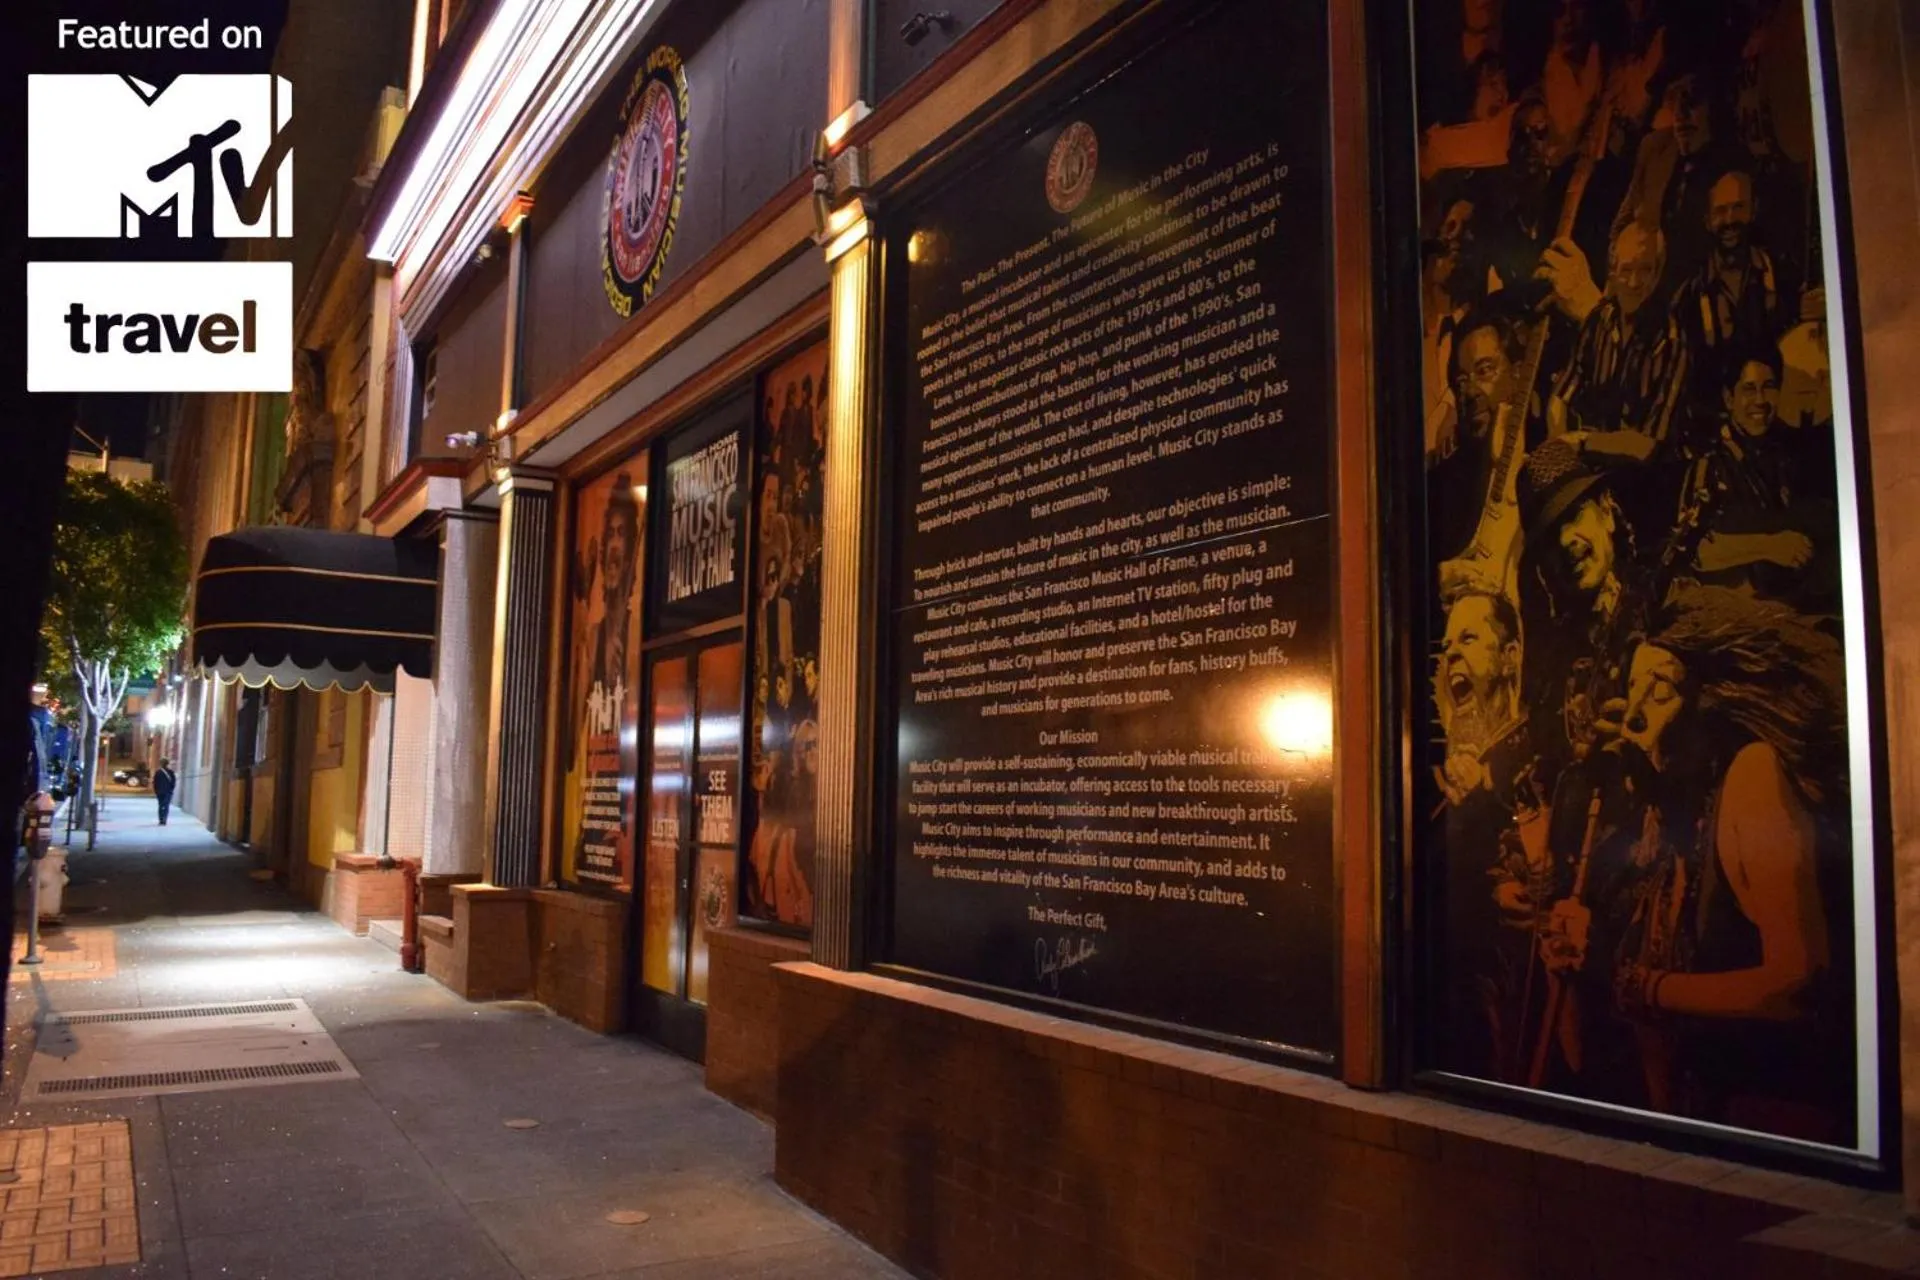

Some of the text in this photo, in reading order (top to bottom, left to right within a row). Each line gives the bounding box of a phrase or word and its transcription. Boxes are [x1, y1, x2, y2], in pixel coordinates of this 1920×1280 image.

[1211, 163, 1289, 211] be drawn to
[643, 127, 693, 303] MUSICIAN
[1146, 190, 1282, 267] movement of the beat
[1137, 217, 1276, 298] gave us the Summer of
[1127, 298, 1162, 323] 1970's
[1163, 285, 1186, 307] and
[1218, 269, 1231, 283] to
[1234, 257, 1256, 276] the
[1155, 318, 1167, 335] of
[1169, 312, 1189, 329] the
[1237, 282, 1262, 300] San
[1132, 302, 1276, 368] working musician and a
[1185, 356, 1206, 372] has
[1208, 333, 1255, 363] eroded
[1257, 326, 1281, 345] the
[1240, 352, 1277, 382] quick
[1140, 380, 1289, 441] physical community has
[1158, 409, 1284, 456] Music City stands as
[689, 441, 739, 503] FRANCISCO
[671, 484, 737, 552] MUSIC
[1085, 520, 1106, 537] and
[1145, 508, 1167, 522] our
[1168, 492, 1226, 516] objective
[1228, 486, 1239, 501] is
[1241, 474, 1291, 498] simple:
[1089, 547, 1099, 559] in
[1101, 542, 1119, 557] the
[1144, 535, 1158, 547] as
[1159, 525, 1185, 543] well
[1186, 525, 1200, 537] as
[1203, 517, 1224, 533] the
[667, 530, 735, 604] HALL OF FAME
[1076, 601, 1091, 612] an
[1091, 591, 1135, 609] Internet
[1138, 585, 1153, 601] TV
[1203, 573, 1230, 590] fifty
[1232, 568, 1263, 588] plug
[1266, 558, 1294, 578] and
[1091, 568, 1123, 585] Music
[1124, 562, 1147, 579] Hall
[1148, 558, 1162, 574] of
[1201, 553, 1209, 563] a
[1259, 540, 1268, 551] a
[1118, 612, 1140, 630] and
[1141, 615, 1149, 626] a
[1151, 598, 1225, 625] hotel/hostel
[1227, 596, 1247, 613] for
[1250, 591, 1273, 609] the
[1084, 642, 1105, 659] and
[1107, 639, 1155, 659] preserve
[1157, 633, 1178, 649] the
[1180, 630, 1203, 646] San
[1206, 622, 1268, 643] Francisco
[1271, 617, 1297, 636] Bay
[1077, 673, 1084, 684] a
[1085, 663, 1147, 683] destination
[1149, 661, 1166, 676] for
[1200, 654, 1246, 670] history
[1060, 689, 1173, 712] generations to come.
[708, 769, 727, 791] SEE
[1077, 751, 1148, 769] economically
[1150, 749, 1187, 765] viable
[1189, 747, 1238, 764] musical
[700, 794, 732, 820] THEM
[1070, 776, 1290, 795] offering access to the tools necessary
[652, 818, 679, 838] LISTEN
[1056, 802, 1297, 824] musicians and new breakthrough artists.
[1066, 827, 1270, 849] performance and entertainment. It
[1099, 852, 1111, 867] in
[1111, 857, 1132, 868] our
[1133, 857, 1204, 877] community,
[1207, 859, 1232, 875] and
[1235, 861, 1268, 878] adds
[1271, 864, 1287, 879] to
[1082, 876, 1133, 894] Francisco
[1134, 880, 1157, 900] Bay
[1158, 882, 1196, 900] Area's
[1198, 887, 1248, 905] culture.
